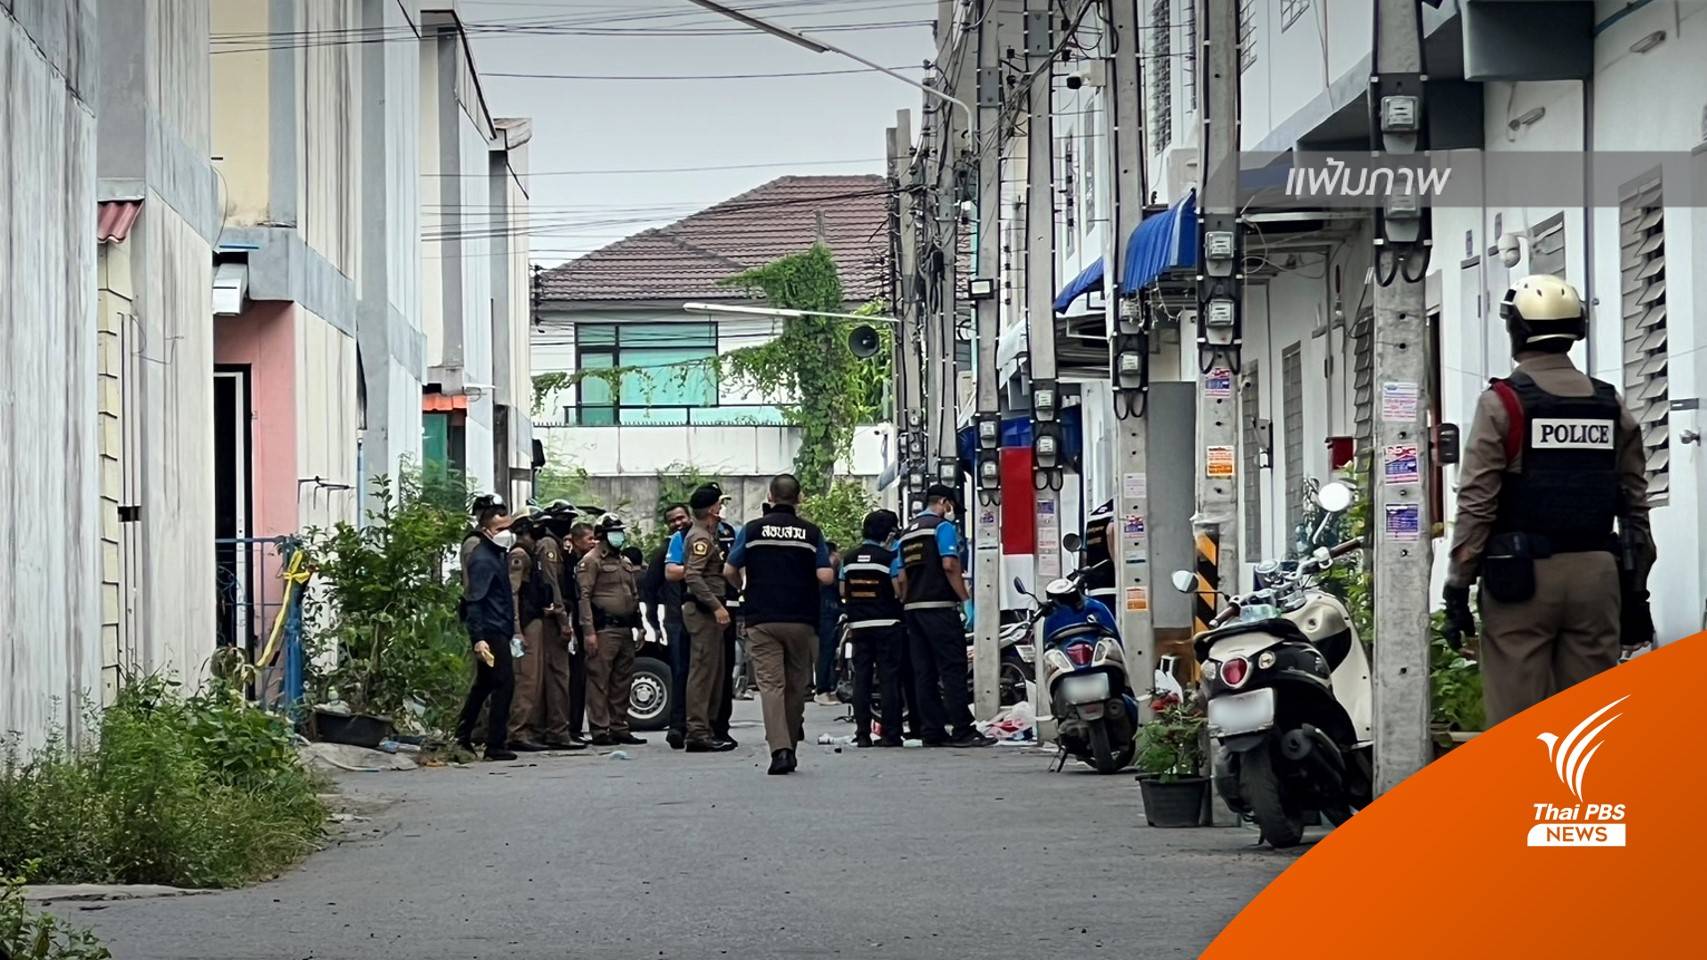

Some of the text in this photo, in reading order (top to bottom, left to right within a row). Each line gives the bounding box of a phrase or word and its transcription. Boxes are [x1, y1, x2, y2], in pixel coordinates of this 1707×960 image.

[1540, 424, 1609, 444] POLICE
[761, 524, 806, 540] สอบสวน
